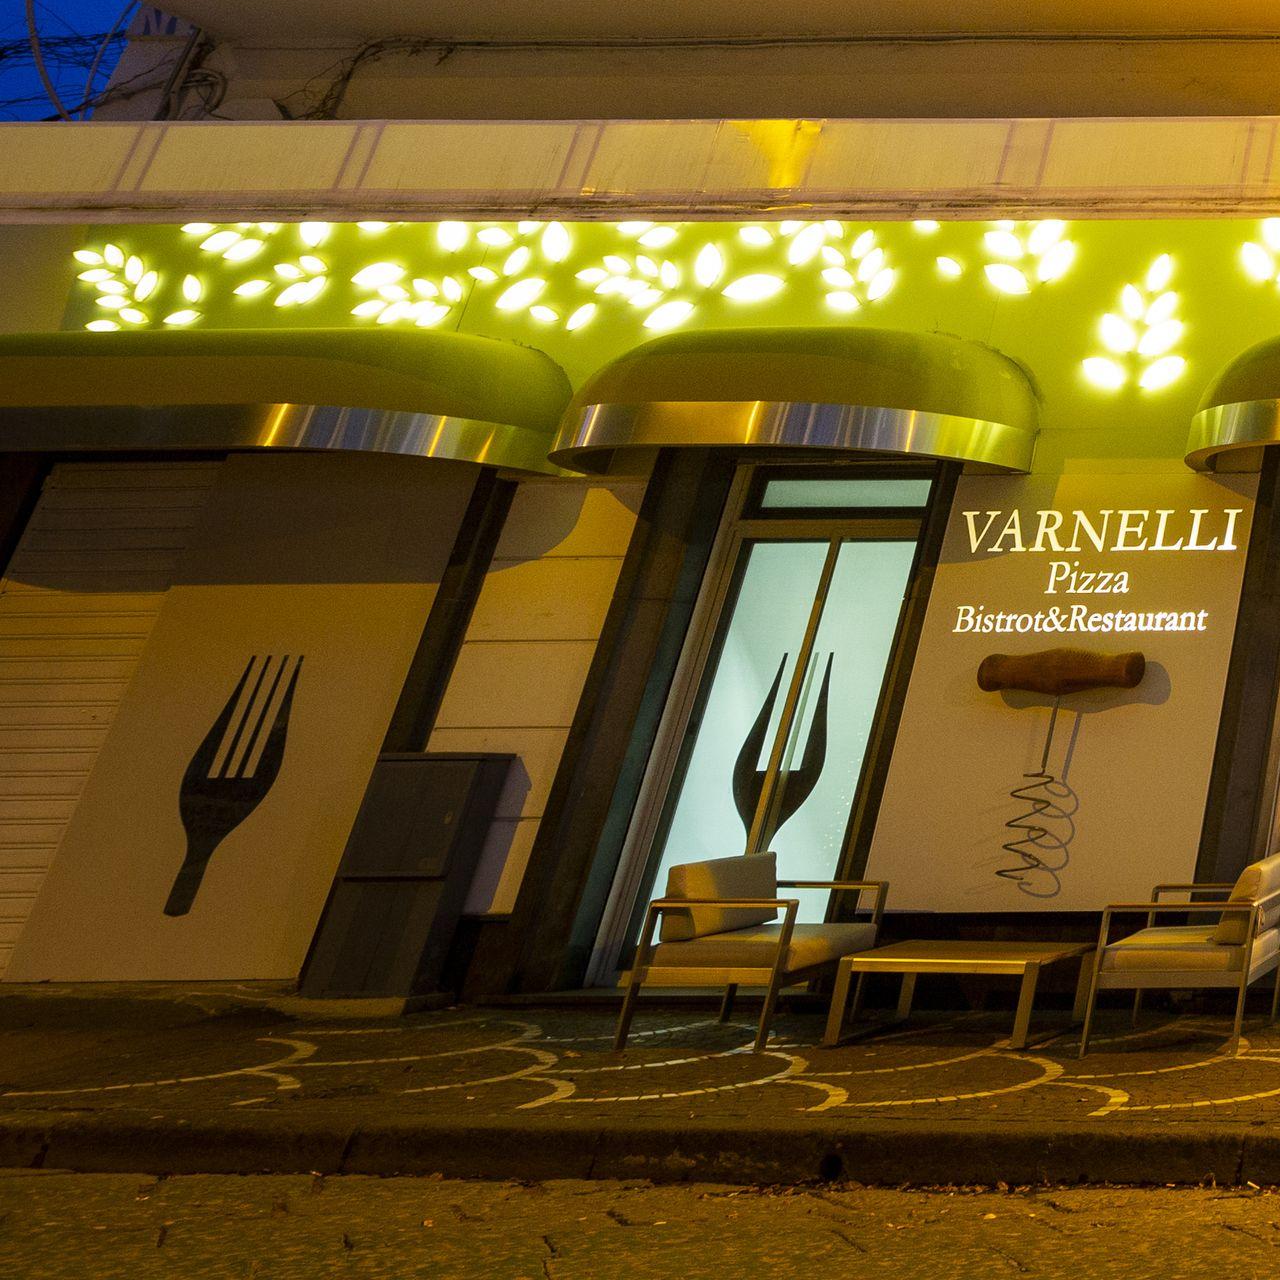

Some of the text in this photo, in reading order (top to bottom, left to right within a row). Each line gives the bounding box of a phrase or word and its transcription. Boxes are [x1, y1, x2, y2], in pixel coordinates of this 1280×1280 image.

[961, 508, 1244, 554] VARNELLI
[1044, 561, 1130, 594] Pizza
[951, 604, 1209, 634] Bistrot&Restaurant
